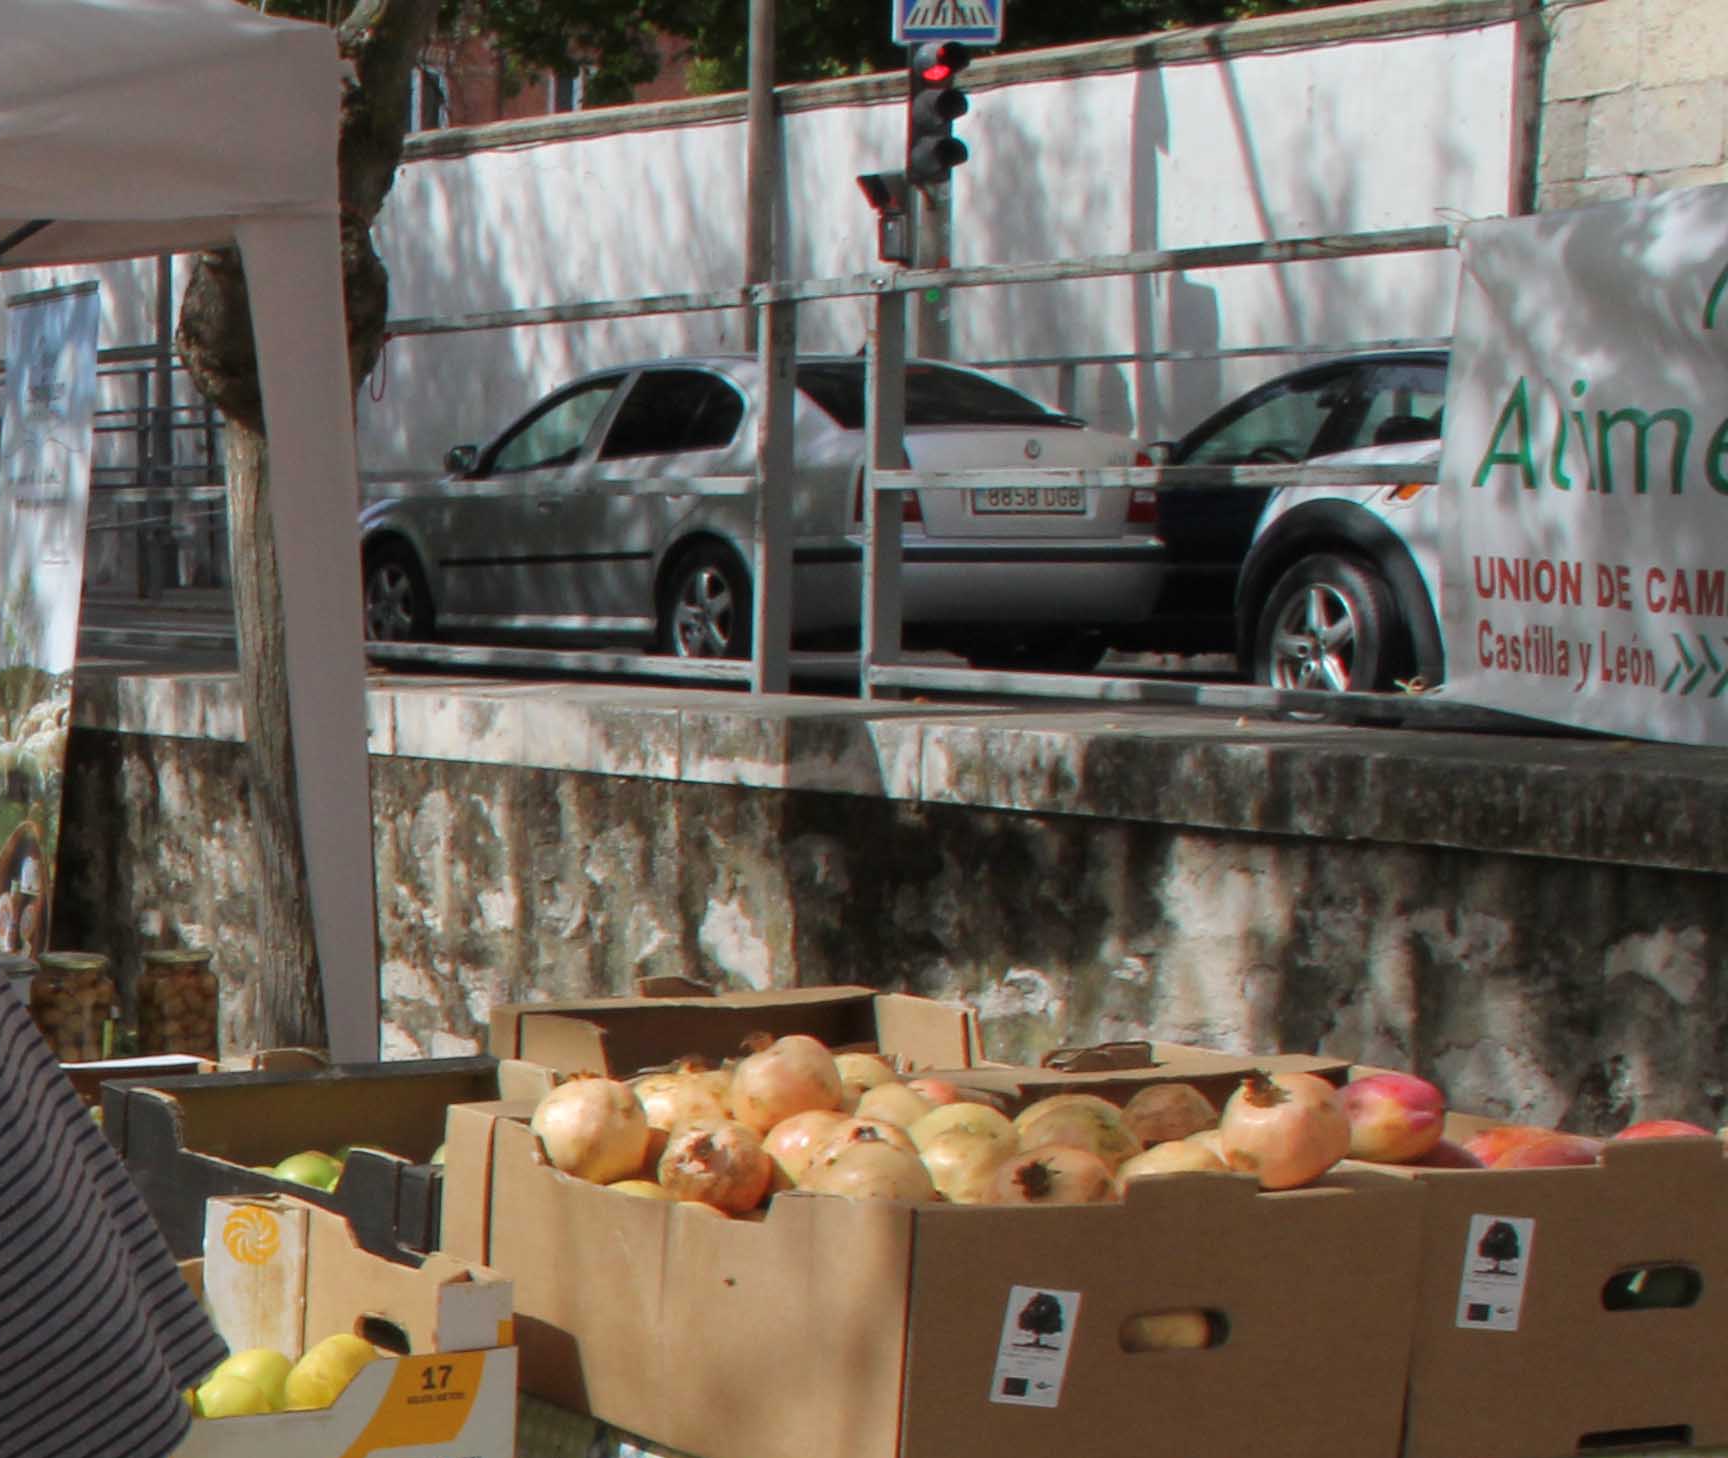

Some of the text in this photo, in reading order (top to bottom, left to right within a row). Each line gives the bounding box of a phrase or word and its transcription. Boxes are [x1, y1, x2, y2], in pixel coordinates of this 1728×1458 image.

[1473, 555, 1582, 606] UNION
[1596, 562, 1632, 611] DE
[1477, 618, 1656, 693] Castilla y León
[420, 1364, 453, 1390] 17
